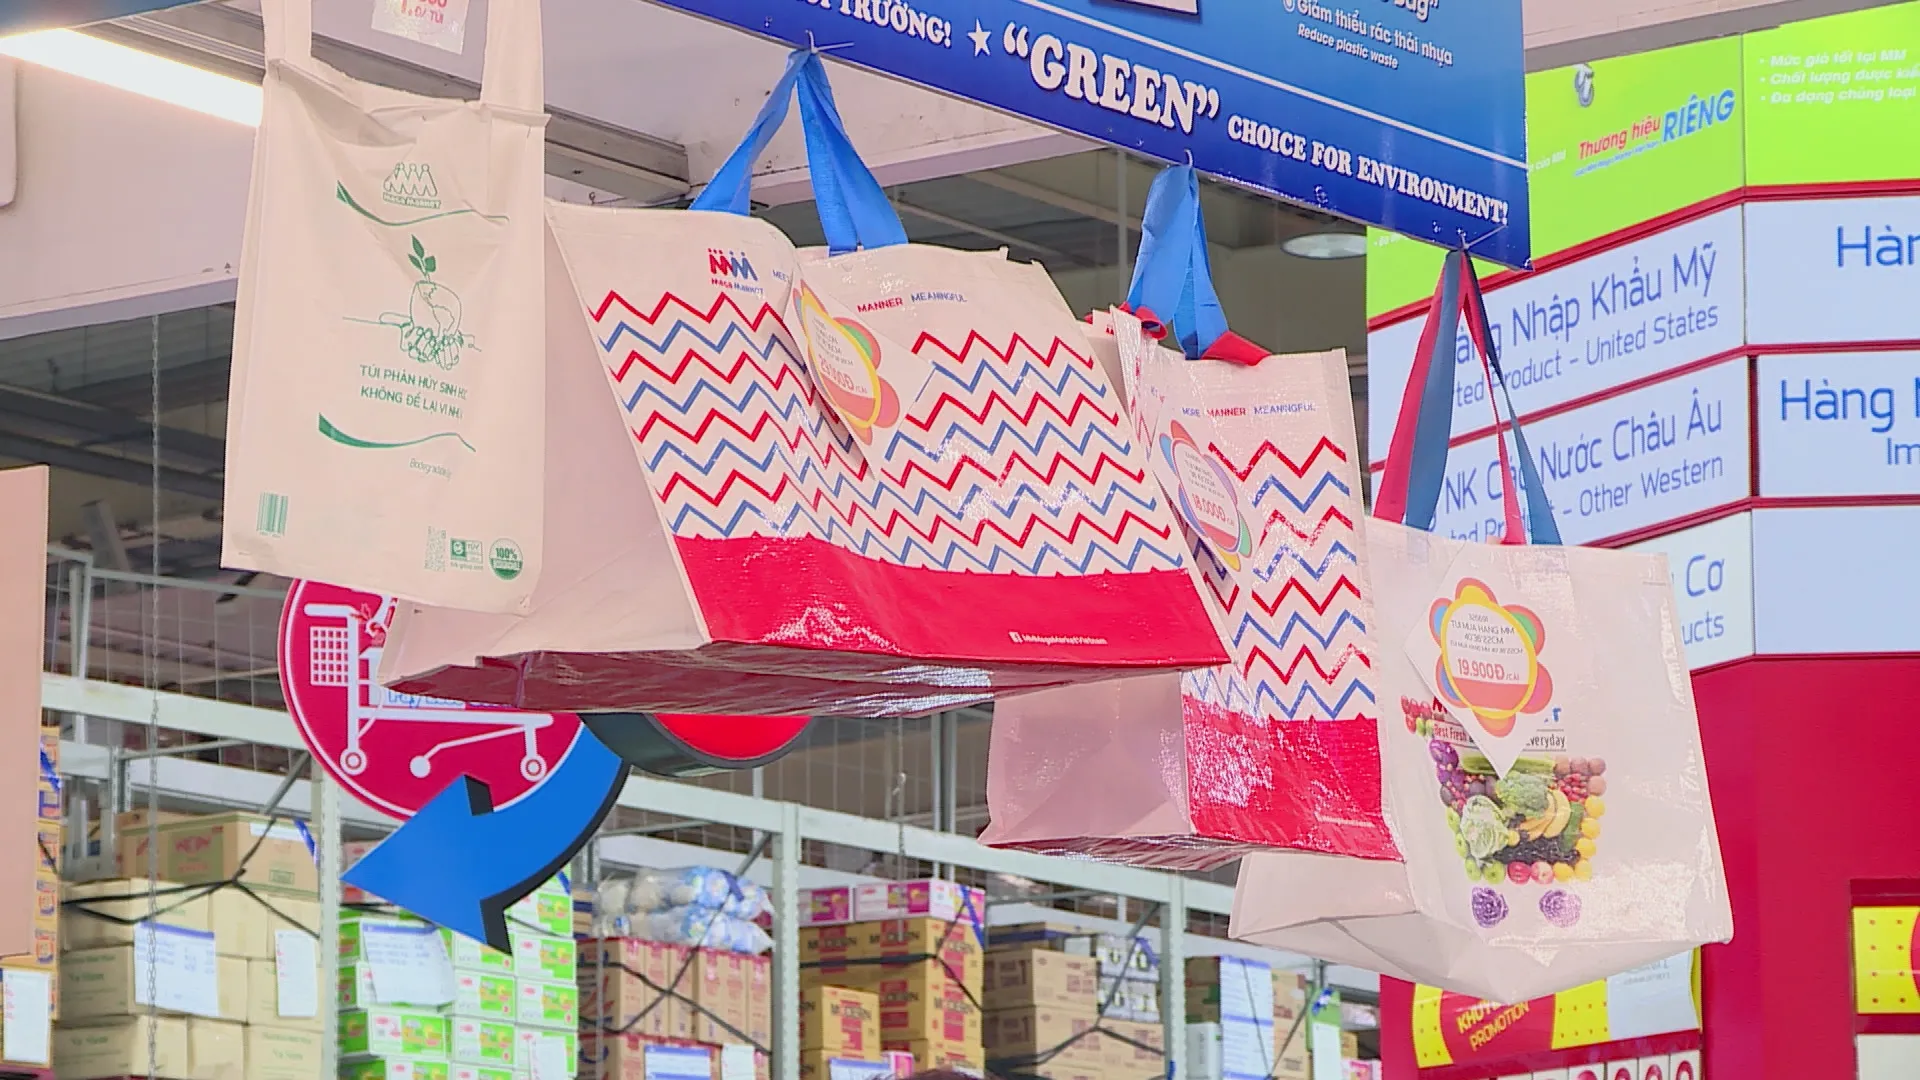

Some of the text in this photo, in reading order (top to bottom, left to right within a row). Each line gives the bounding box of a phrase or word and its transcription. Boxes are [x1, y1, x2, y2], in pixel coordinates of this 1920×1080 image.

[1298, 23, 1399, 69] Reduce plastic waste
[1335, 9, 1367, 36] thiểu
[1370, 22, 1392, 43] rác
[1394, 29, 1418, 53] thải
[1421, 41, 1453, 67] nhựa
[1003, 21, 1221, 134] “GREEN”
[1579, 115, 1661, 160] Thương hiệu
[1663, 89, 1736, 142] RIÊNG
[1227, 115, 1509, 226] CHOICE FOR ENVIRONMENT!
[857, 296, 903, 314] MANNER
[911, 291, 967, 304] MEANINGFUL
[1512, 294, 1581, 346] Nhập
[1592, 255, 1662, 320] Khẩu
[1673, 241, 1717, 297] Mỹ
[1586, 322, 1646, 366] United
[1652, 305, 1719, 345] States
[360, 364, 381, 378] TÚI
[360, 386, 403, 404] KHÔNG
[1780, 378, 1895, 433] Hàng
[1446, 467, 1478, 515] NK
[1540, 433, 1602, 484] Nước
[1613, 410, 1676, 461] Châu
[1687, 387, 1722, 440] Âu
[1579, 482, 1632, 517] Other
[1641, 456, 1723, 499] Western
[1686, 554, 1725, 597] Cơ
[1681, 610, 1725, 645] ucts
[1458, 658, 1505, 681] 19.900Đ
[1526, 734, 1566, 748] veryday
